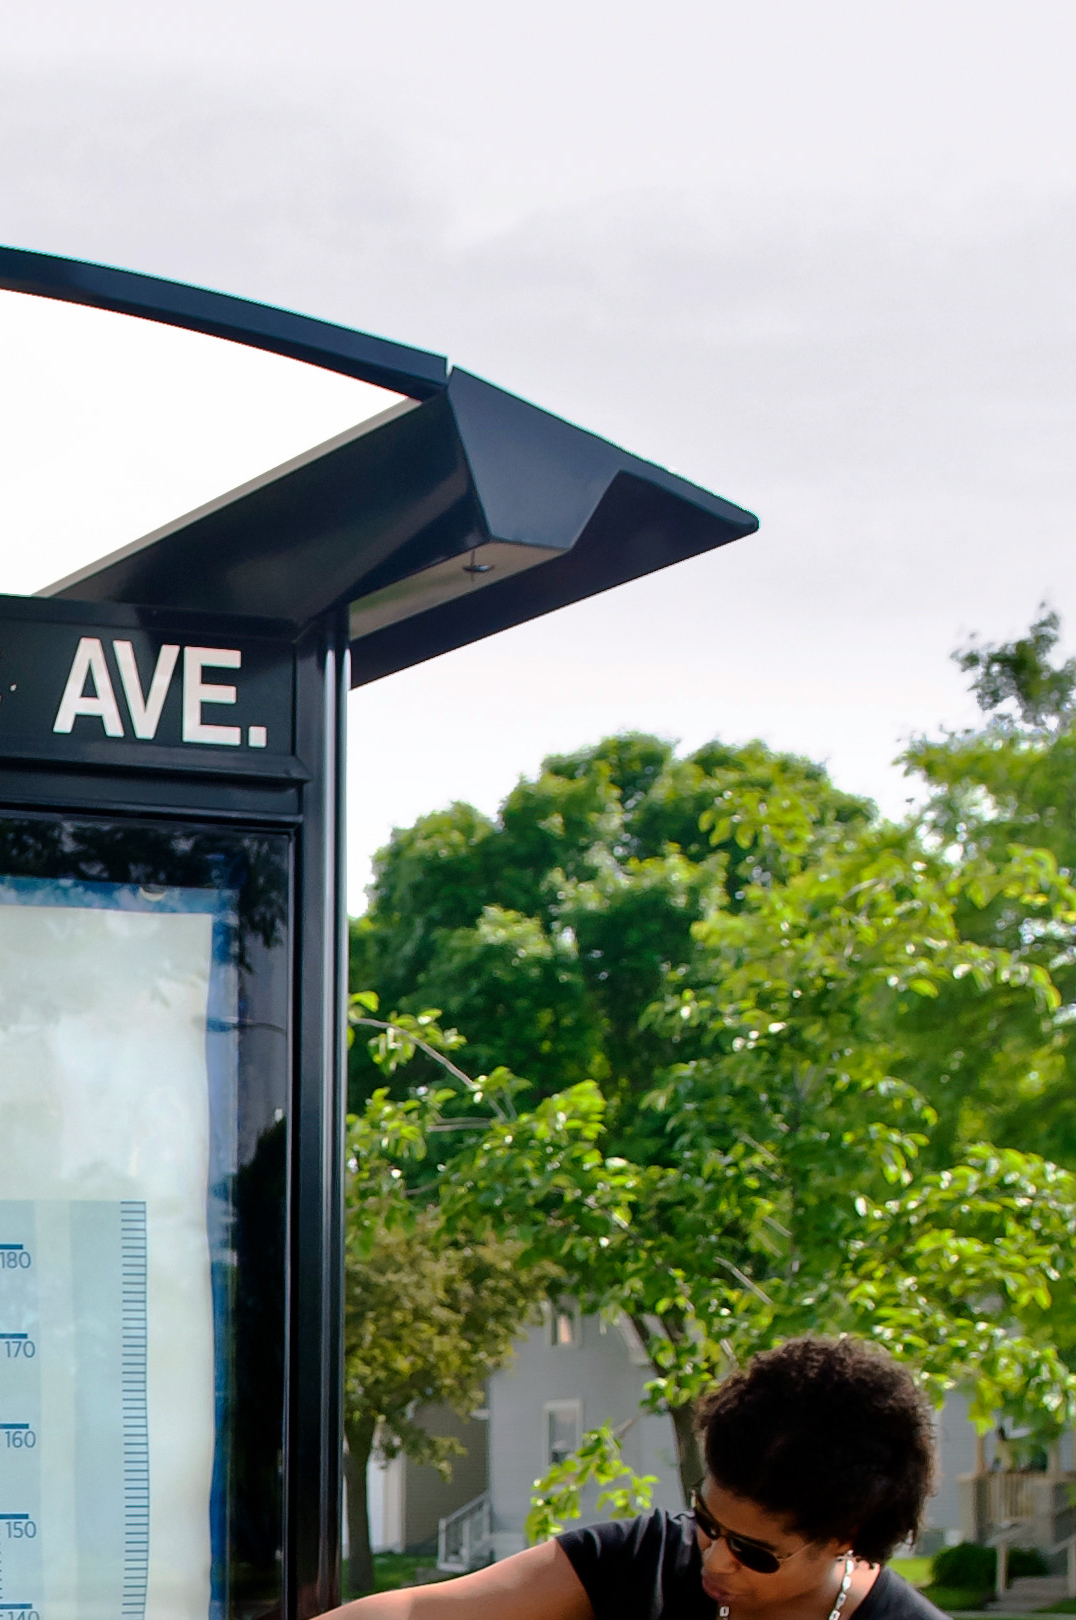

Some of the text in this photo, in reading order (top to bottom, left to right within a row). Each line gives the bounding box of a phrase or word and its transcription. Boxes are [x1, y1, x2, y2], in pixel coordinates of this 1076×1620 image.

[54, 638, 266, 747] AVE.
[0, 1252, 31, 1268] 180
[5, 1341, 35, 1358] 170
[5, 1431, 35, 1448] 160
[6, 1521, 36, 1538] 150
